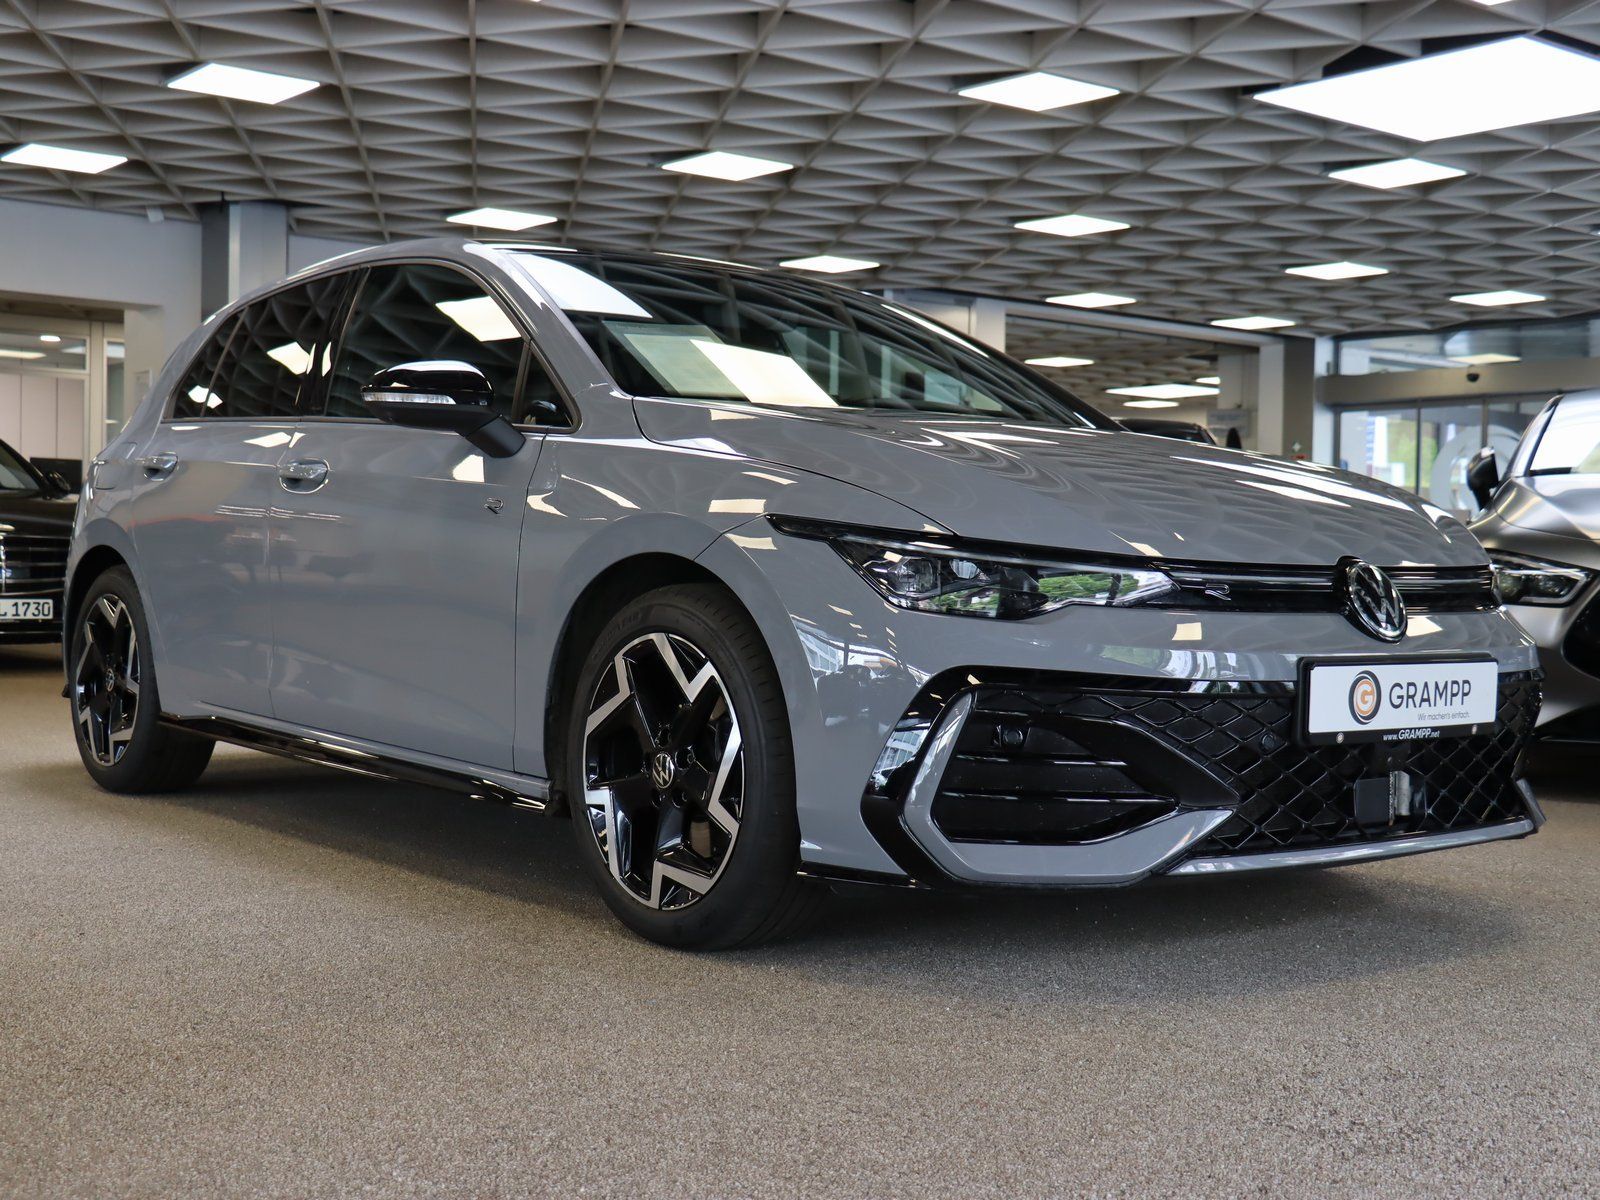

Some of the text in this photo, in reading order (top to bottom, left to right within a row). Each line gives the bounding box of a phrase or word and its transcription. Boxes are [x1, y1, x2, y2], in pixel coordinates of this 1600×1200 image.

[12, 601, 51, 617] 1730
[1389, 680, 1471, 709] GRAMPP
[1383, 728, 1440, 740] www.GRAMPP.net
